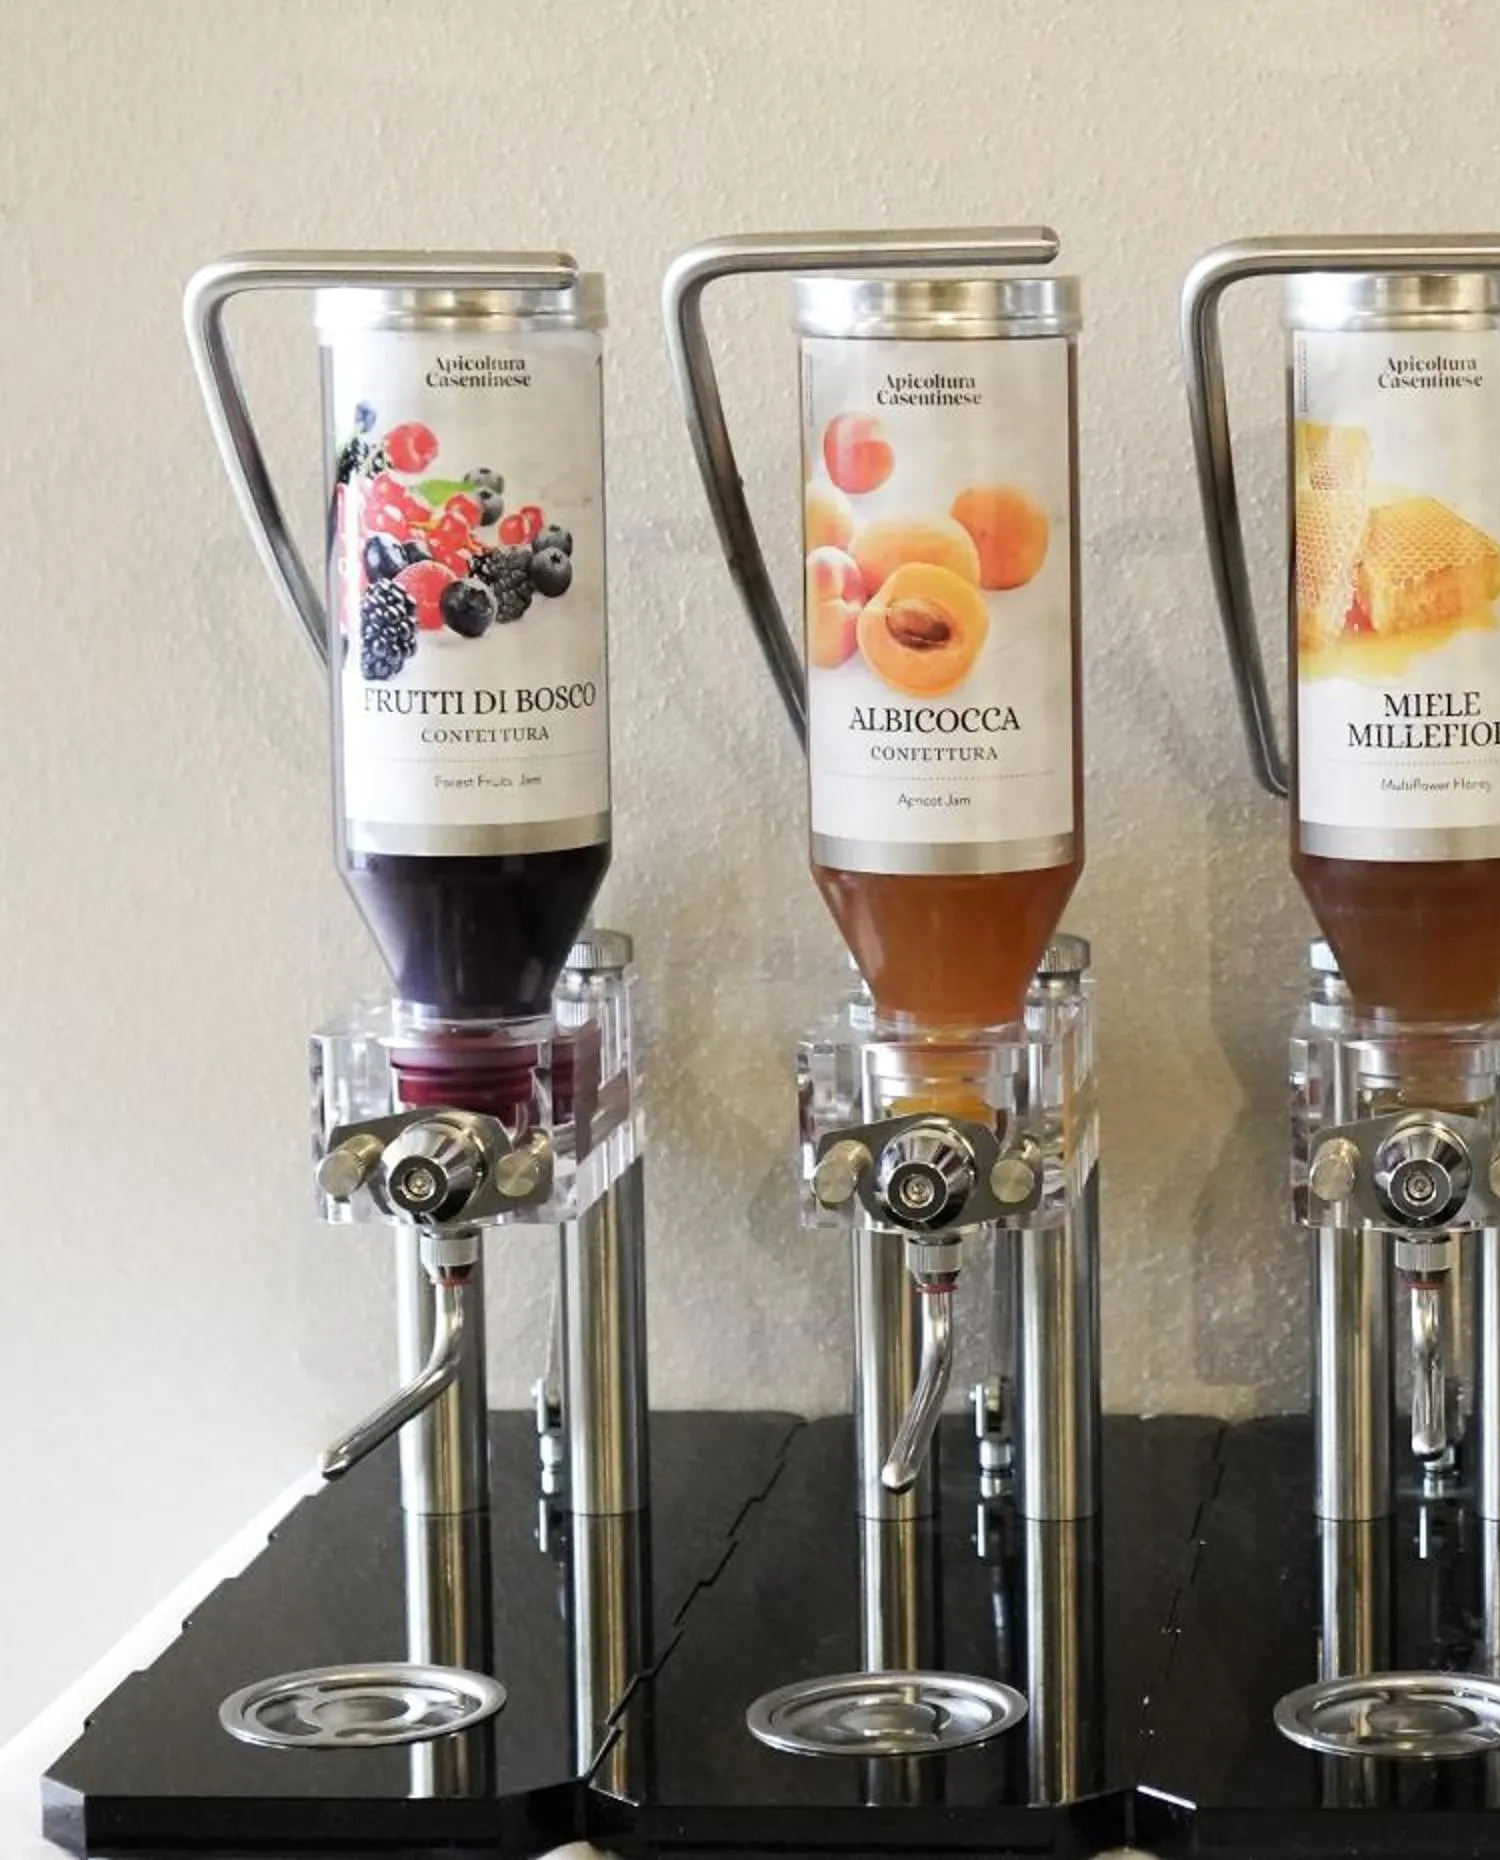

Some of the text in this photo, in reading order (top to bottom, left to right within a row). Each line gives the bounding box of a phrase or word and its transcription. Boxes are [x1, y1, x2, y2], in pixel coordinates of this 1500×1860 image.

[436, 355, 525, 374] Apicoltura
[1387, 355, 1477, 375] Apicoltura
[425, 372, 531, 387] Casentinese
[885, 373, 976, 392] Apicoltura
[1377, 372, 1482, 389] Casentinese
[876, 389, 982, 405] Casentinese
[363, 681, 597, 715] FRUTTI DI BOSCO
[1383, 691, 1481, 718] MIELE
[849, 706, 1020, 733] ALBICOCCA
[421, 725, 550, 744] CONFETTURA
[870, 745, 999, 762] CONFETTURA
[897, 793, 972, 809] Apricot Jam
